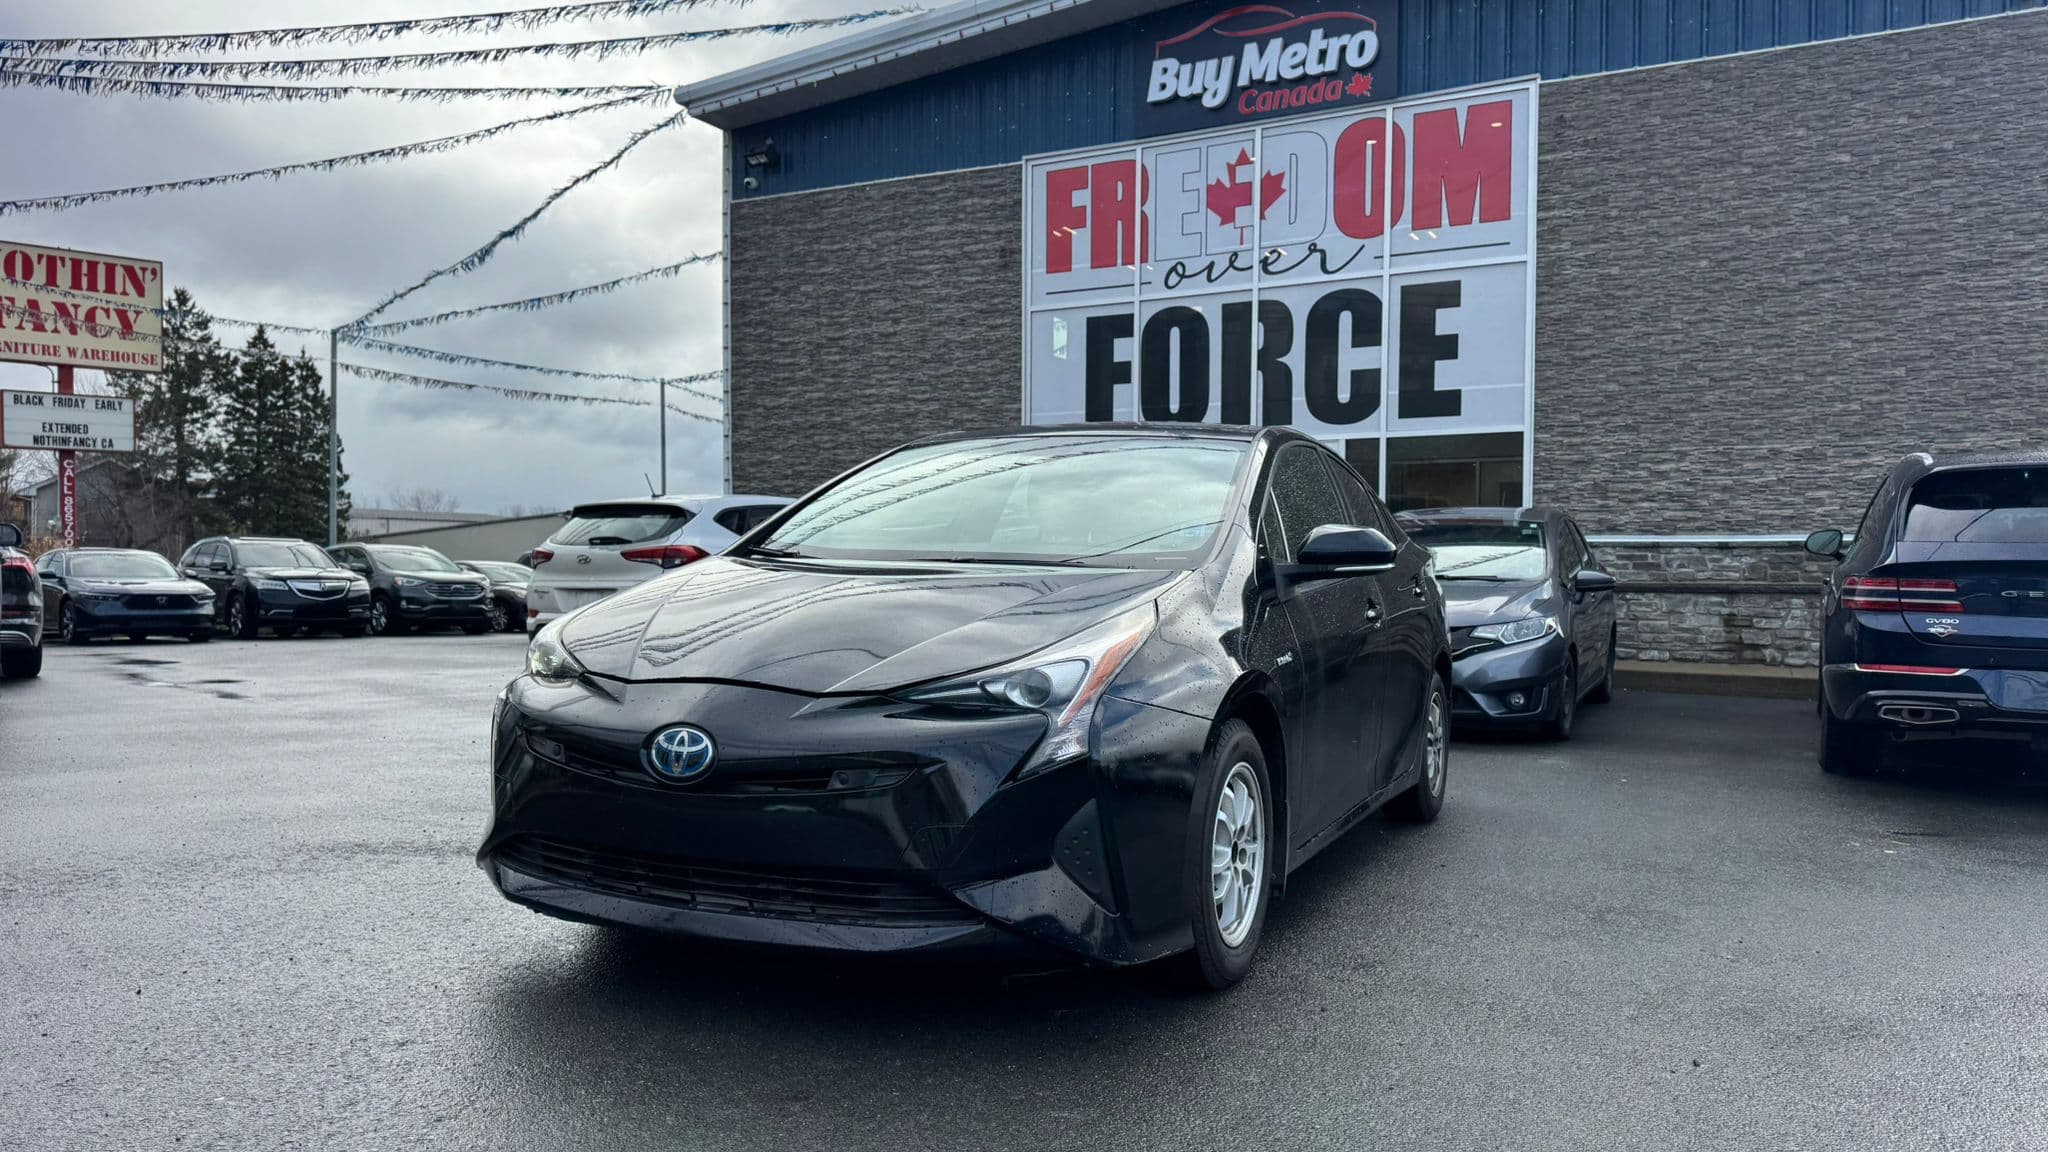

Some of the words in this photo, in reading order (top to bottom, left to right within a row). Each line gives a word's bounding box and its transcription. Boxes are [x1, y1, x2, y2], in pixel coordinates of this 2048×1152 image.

[1147, 55, 1235, 110] Buy
[1237, 28, 1379, 88] Metro
[1238, 77, 1344, 115] Canada
[1045, 99, 1512, 275] FREEDOM
[0, 248, 158, 299] OTHIN'
[1163, 243, 1366, 291] over
[0, 340, 61, 358] NITURE
[66, 346, 159, 366] WAREHOUSE
[1084, 279, 1462, 426] FORCE
[13, 394, 45, 407] BLACK
[53, 396, 86, 409] FRIDAY
[95, 399, 123, 411] EARLY
[33, 435, 97, 448] NOTHINFANCY
[42, 421, 88, 434] EXTENDED
[63, 459, 74, 494] CALL
